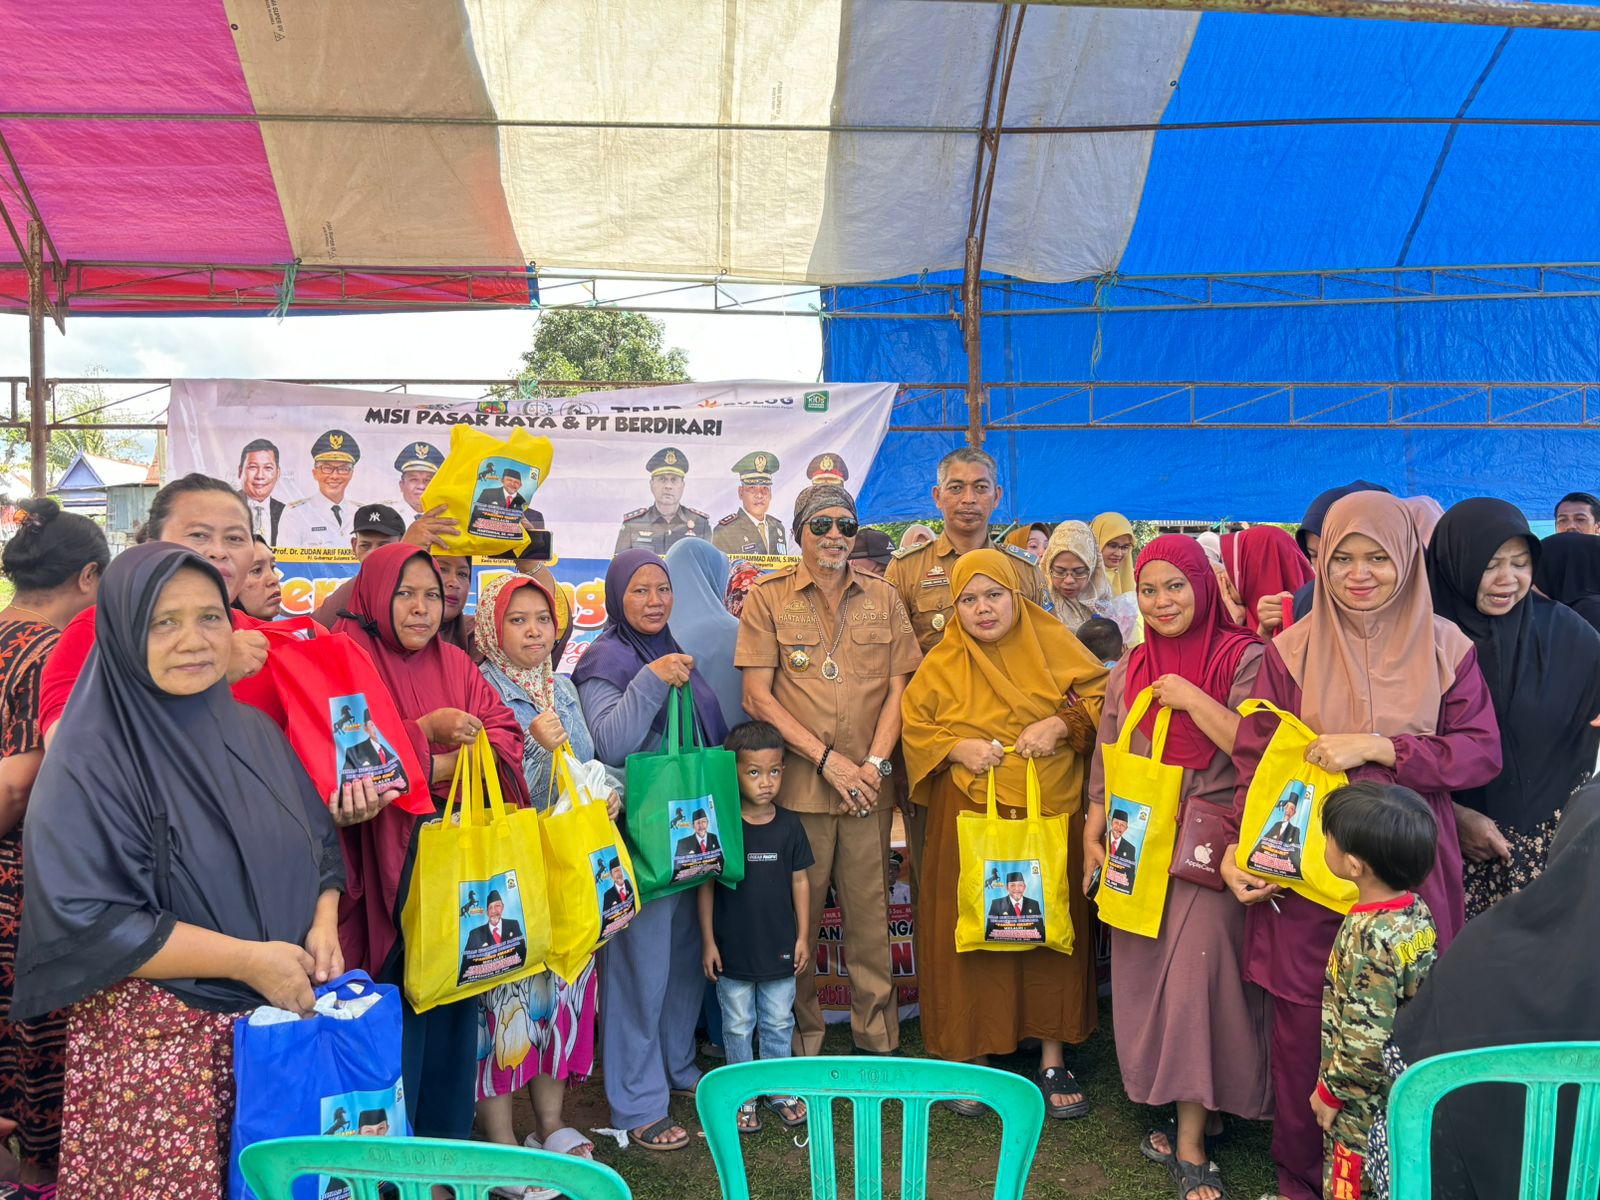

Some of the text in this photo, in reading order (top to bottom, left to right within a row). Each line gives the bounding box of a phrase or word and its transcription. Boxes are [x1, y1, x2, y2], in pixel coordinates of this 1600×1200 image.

[364, 407, 723, 436] MISI PASAR RAYA & PT BERDIKARI
[300, 548, 321, 556] ZUDAN
[852, 612, 888, 621] KADIS
